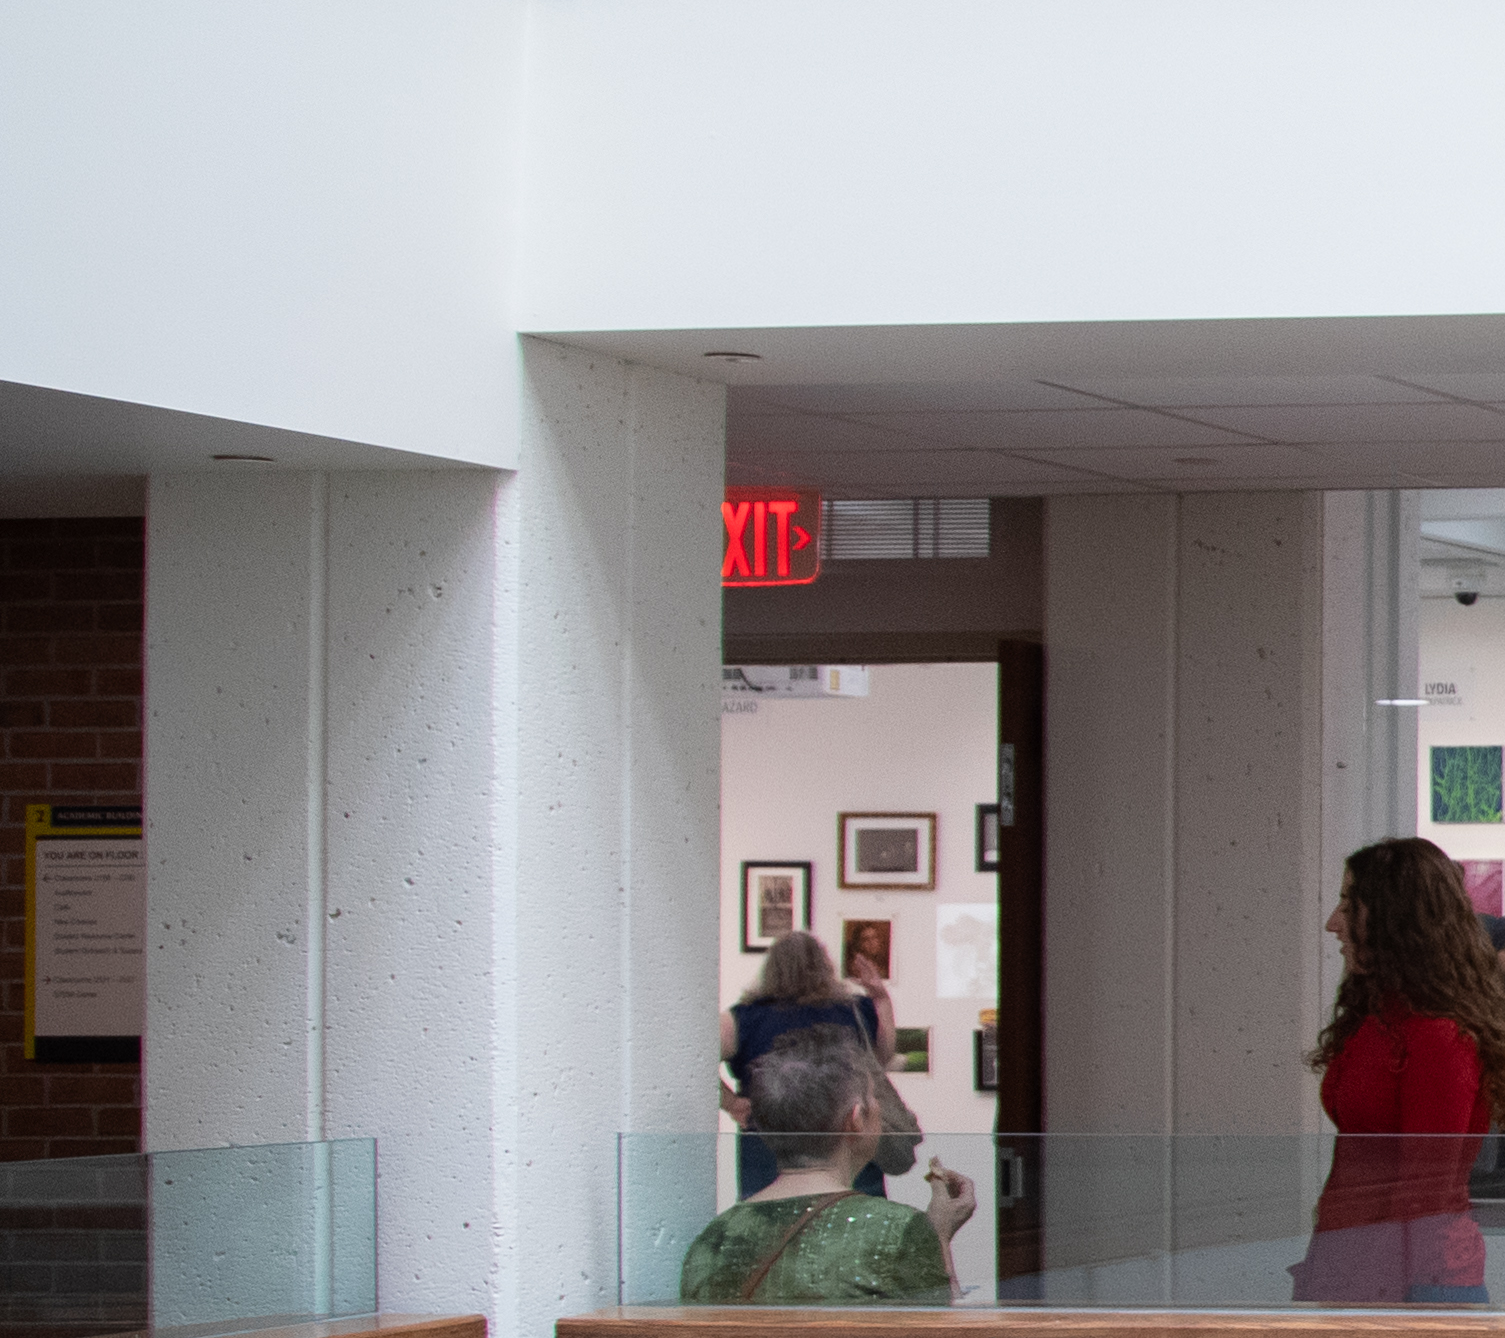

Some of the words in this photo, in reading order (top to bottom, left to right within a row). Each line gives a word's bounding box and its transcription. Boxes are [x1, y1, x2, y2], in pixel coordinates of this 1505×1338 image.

[721, 501, 799, 577] XIT
[1424, 683, 1457, 695] LYDIA
[105, 811, 143, 820] BUILDIN
[45, 851, 64, 861] YOU
